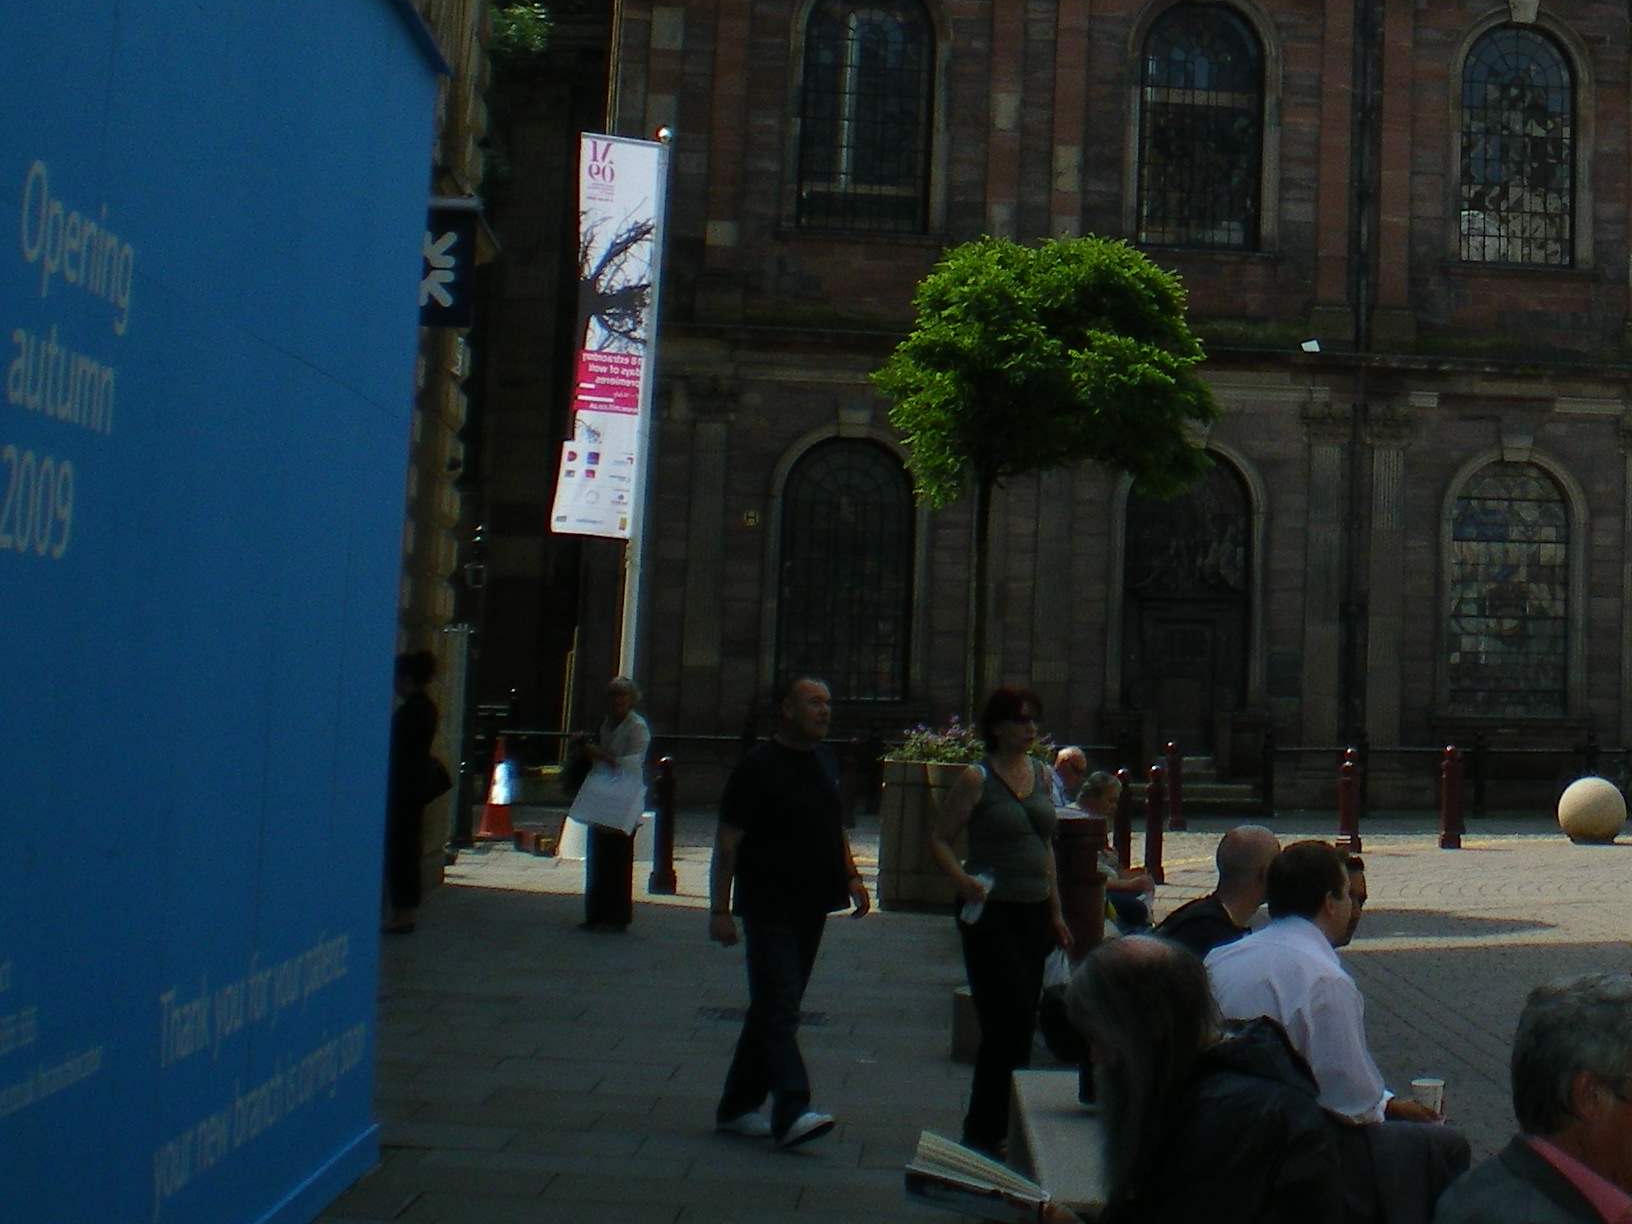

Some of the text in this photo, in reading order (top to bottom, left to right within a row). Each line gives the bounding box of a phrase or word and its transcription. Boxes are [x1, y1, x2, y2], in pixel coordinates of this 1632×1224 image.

[20, 159, 134, 336] Opening
[7, 322, 114, 435] autumn
[0, 443, 75, 560] 2009
[159, 974, 210, 1068] Thank
[211, 979, 245, 1064] you
[302, 931, 349, 1014] patience
[152, 1128, 194, 1224] your
[195, 1112, 227, 1172] new
[230, 1056, 285, 1148] branch
